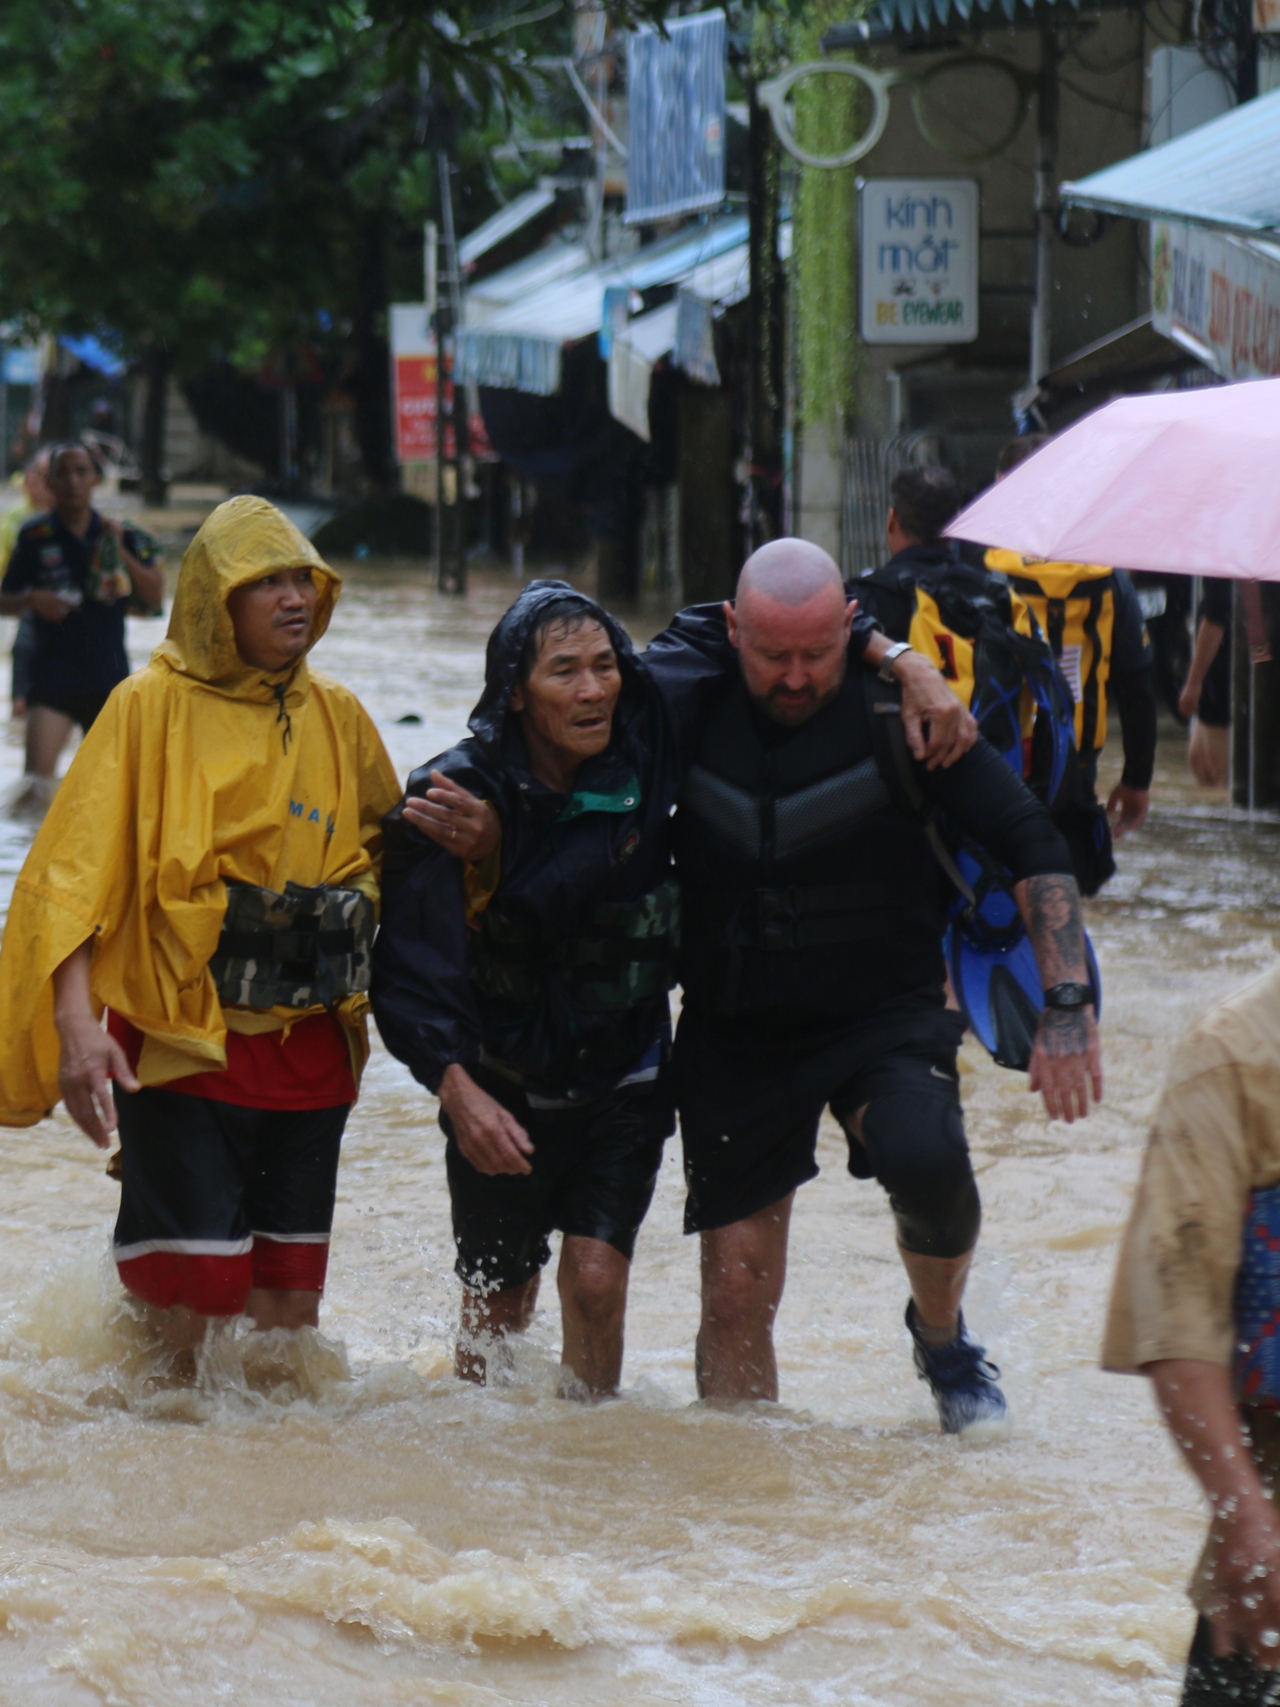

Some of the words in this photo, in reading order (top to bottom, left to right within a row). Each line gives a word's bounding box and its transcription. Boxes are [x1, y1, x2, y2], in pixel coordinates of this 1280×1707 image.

[879, 234, 961, 274] mắt
[876, 301, 900, 327] BE
[903, 301, 965, 326] EYEWEAR
